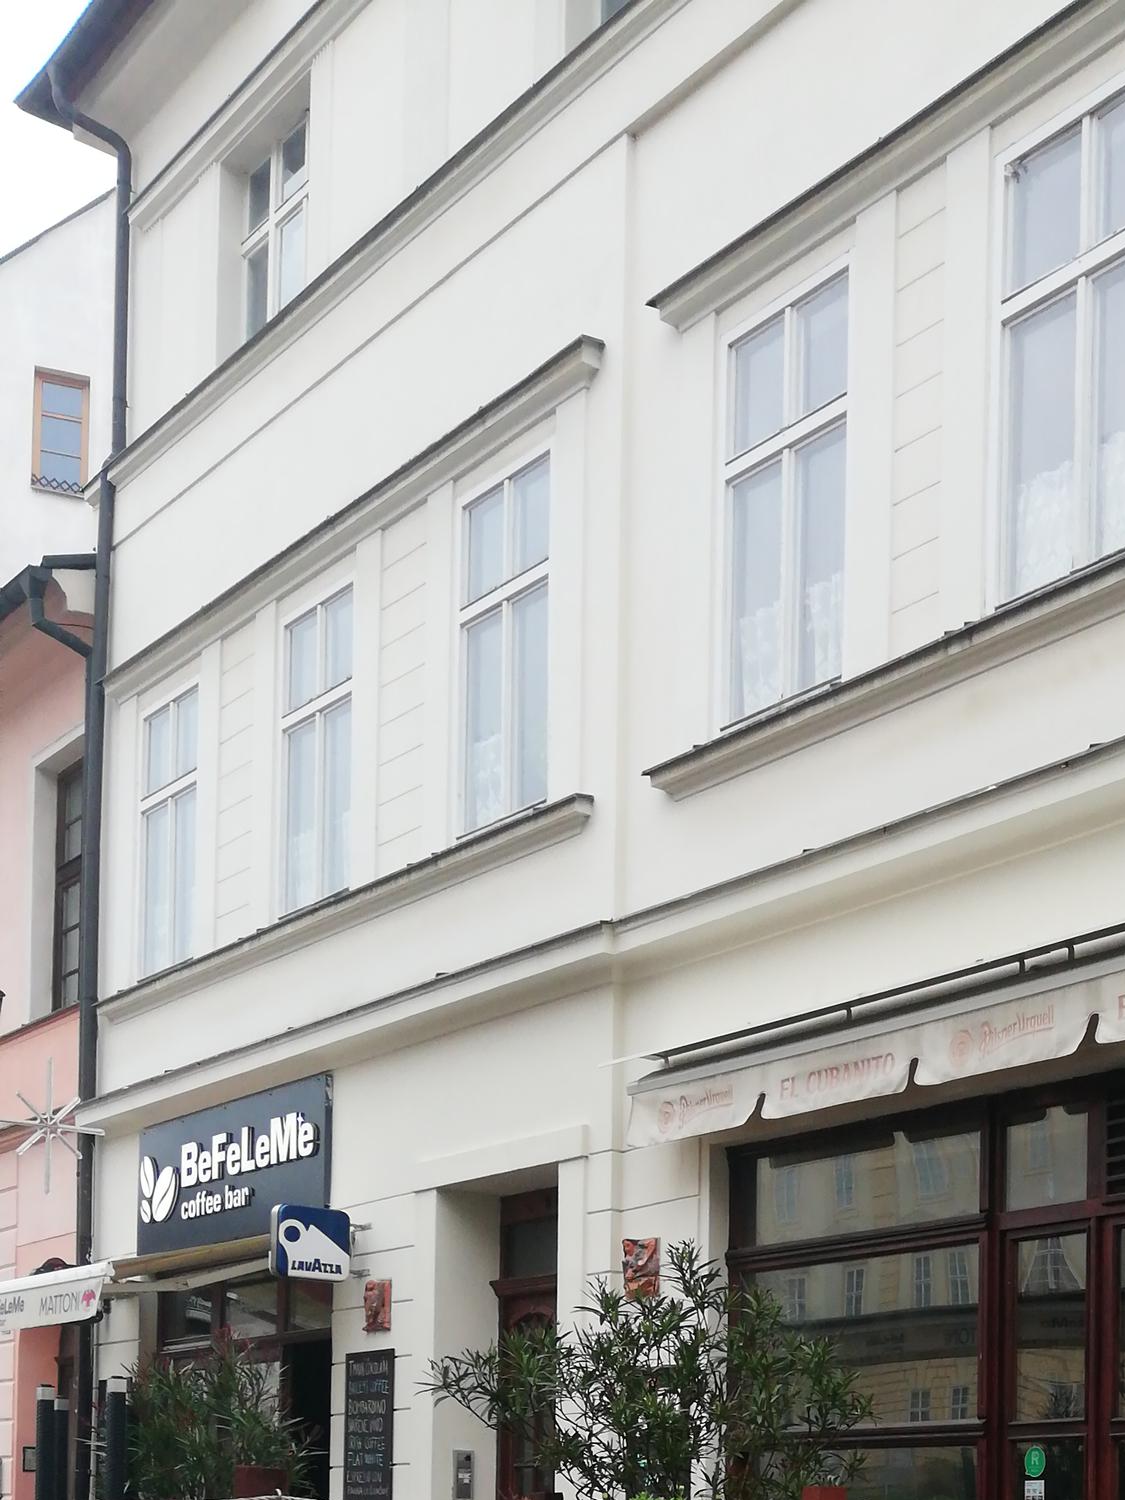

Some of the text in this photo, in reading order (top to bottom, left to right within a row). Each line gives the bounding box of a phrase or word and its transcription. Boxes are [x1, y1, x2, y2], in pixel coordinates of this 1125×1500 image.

[779, 1053, 896, 1100] EL CUBANITO
[181, 1112, 316, 1188] BeFeLeMe
[181, 1185, 250, 1220] coffee bar
[290, 1258, 343, 1275] LAVAZZA
[39, 1292, 81, 1316] MATTONI
